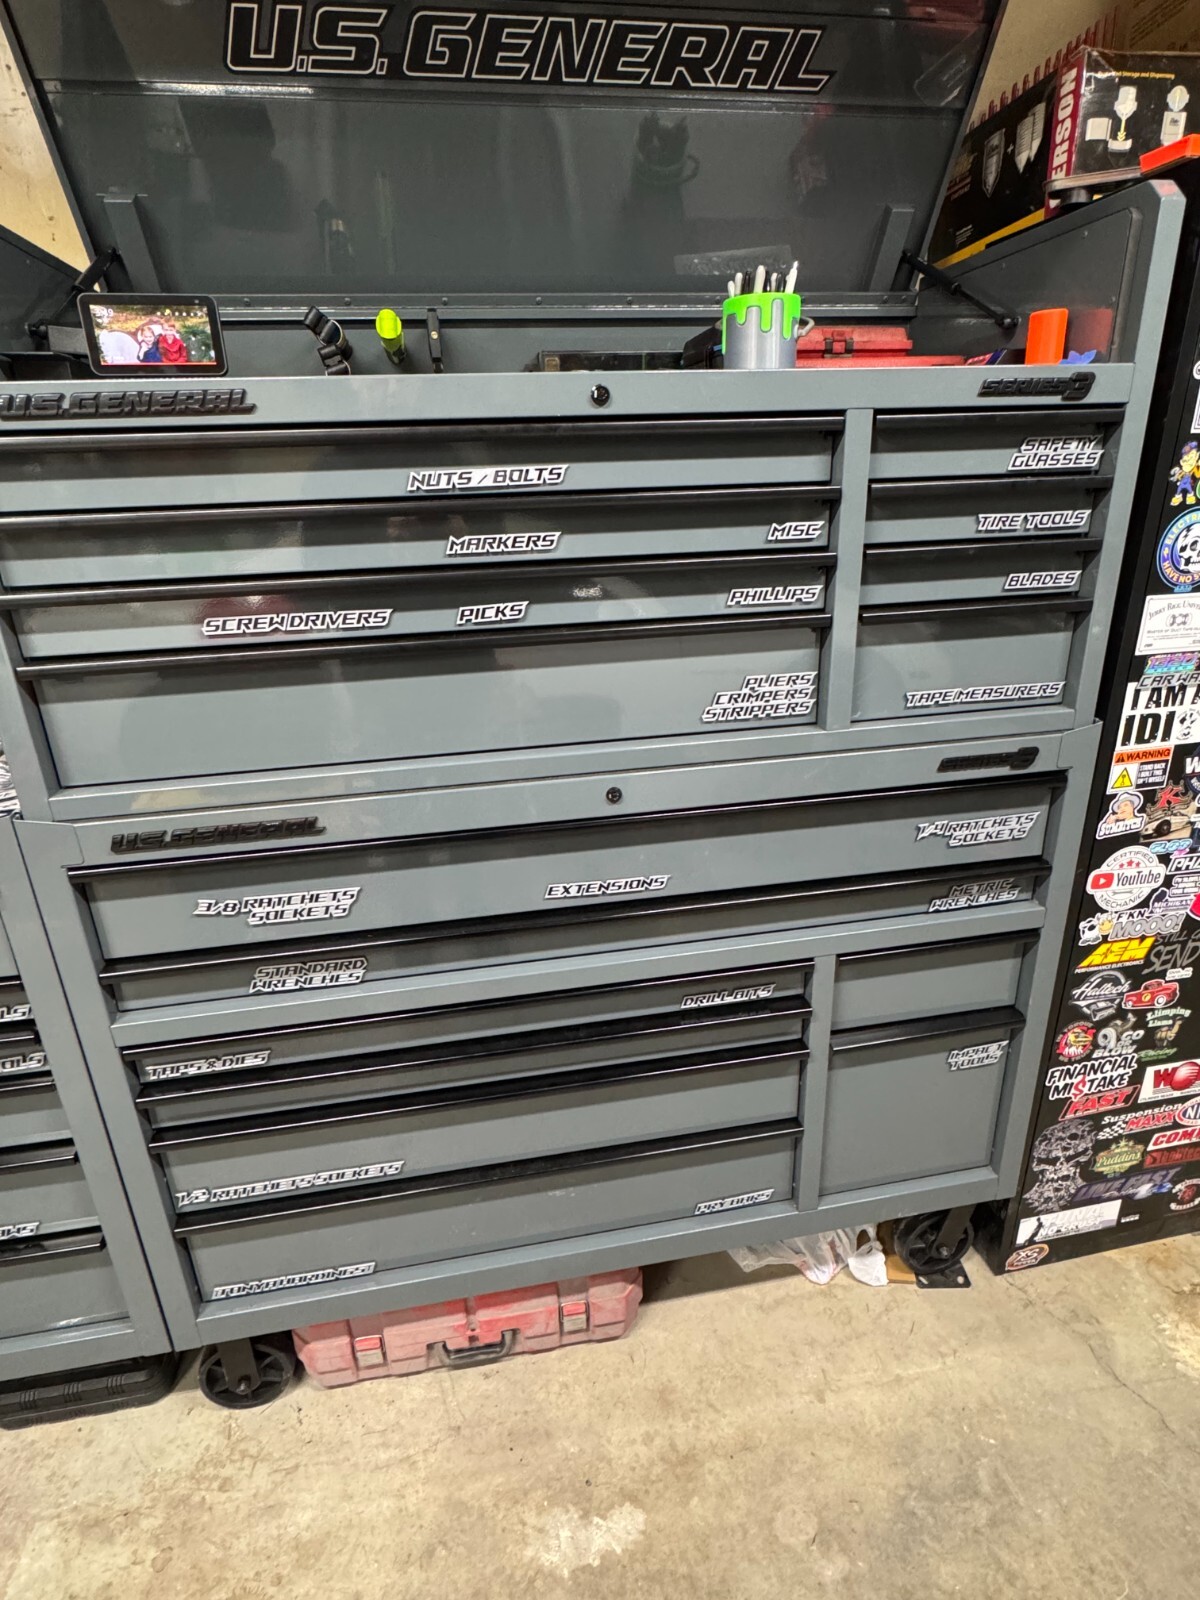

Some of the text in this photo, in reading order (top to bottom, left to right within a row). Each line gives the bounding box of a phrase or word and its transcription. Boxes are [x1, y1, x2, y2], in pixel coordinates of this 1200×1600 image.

[226, 3, 830, 91] U.S. GENERAL
[1051, 67, 1078, 180] ERSON
[978, 377, 1066, 397] SERIES
[69, 388, 257, 417] GENERAL
[1023, 436, 1100, 451] SAFETY
[1011, 451, 1100, 468] GLASSES
[979, 511, 1088, 529] TIRE TOOLS
[769, 522, 822, 539] MISC
[448, 534, 557, 552] MARKERS
[1006, 572, 1077, 587] BLADES
[729, 586, 820, 604] PHILLIPS
[458, 603, 524, 622] PICKS
[745, 673, 813, 688] PLIERS
[1139, 675, 1175, 687] CAR
[714, 687, 811, 705] CRIMPERS
[908, 684, 1061, 706] TAPE MEASURERS
[1131, 688, 1141, 711] I
[1145, 683, 1188, 709] AM
[703, 701, 812, 720] STRIPPERS
[1126, 749, 1171, 760] WARNING
[948, 813, 1037, 834] RATCHETS
[950, 826, 1027, 845] SOCKETS
[1107, 850, 1154, 867] CERTIFIED
[546, 876, 666, 897] EXTENSIONS
[1117, 869, 1160, 886] YouTube
[950, 879, 1014, 897] METRIC
[195, 889, 357, 914] 3/8 RATCHETS
[930, 889, 1019, 911] WRENCHES
[1100, 889, 1144, 908] MECHANIC
[248, 904, 348, 923] SOCKETS
[1110, 914, 1185, 938] MOOO!
[1155, 930, 1188, 945] STILL
[1078, 937, 1156, 967] AEM
[1141, 939, 1200, 975] SEND
[256, 957, 367, 978] STANDARD
[251, 972, 364, 992] WRENCHES
[1073, 978, 1131, 1000] Haltech
[682, 985, 774, 1008] DRILL BITS
[1048, 1055, 1136, 1084] FINANCIAL
[1067, 1090, 1131, 1115] FAST
[1101, 1103, 1182, 1125] Suspension
[1125, 1111, 1175, 1131] MAXX
[212, 1175, 315, 1201] RATCHETS
[314, 1163, 403, 1186] SOCKETS
[696, 1200, 727, 1214] PRY
